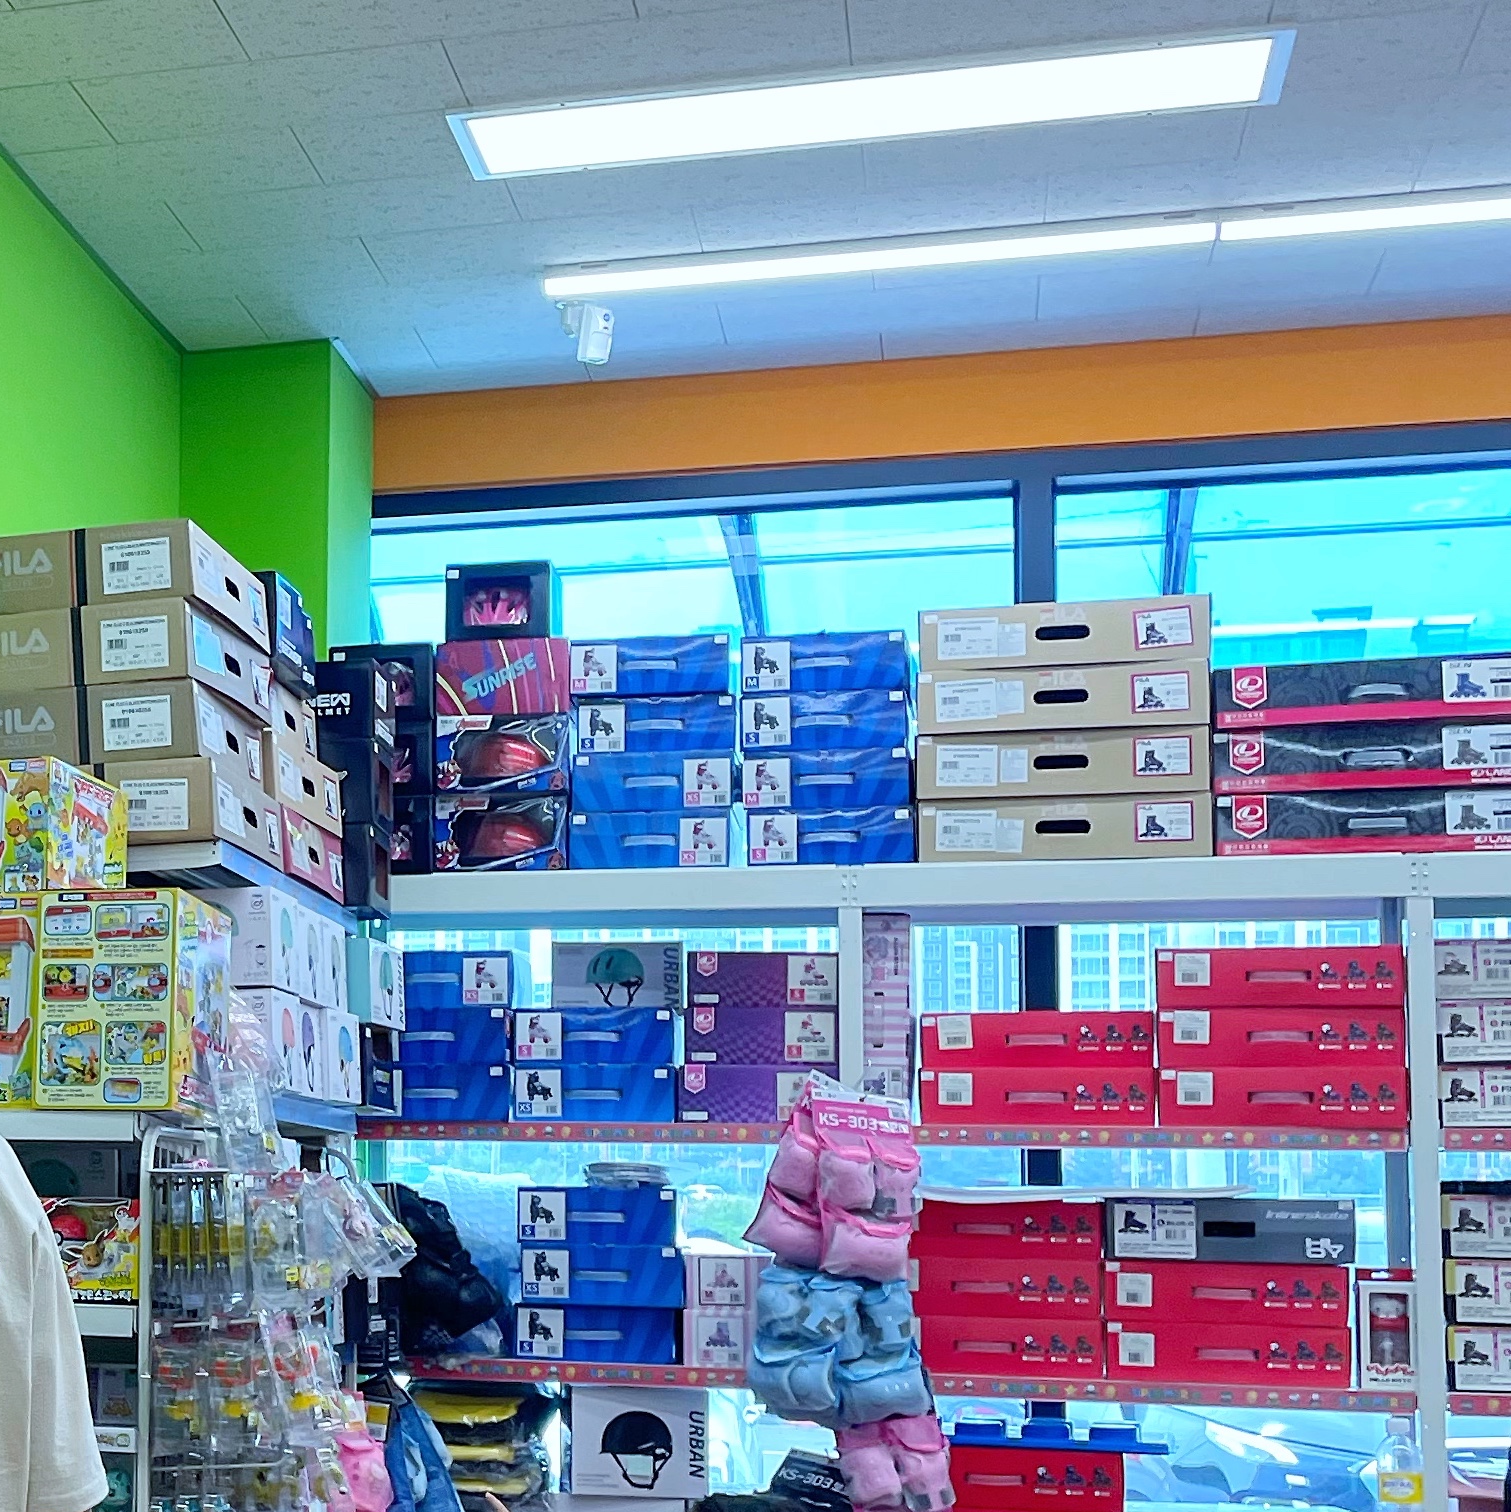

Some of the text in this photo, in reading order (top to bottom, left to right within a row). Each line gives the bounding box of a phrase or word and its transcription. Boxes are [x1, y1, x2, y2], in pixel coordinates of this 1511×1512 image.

[462, 651, 537, 702] SUNRISE
[663, 947, 680, 1010] URBAN
[688, 1410, 705, 1479] URBAN
